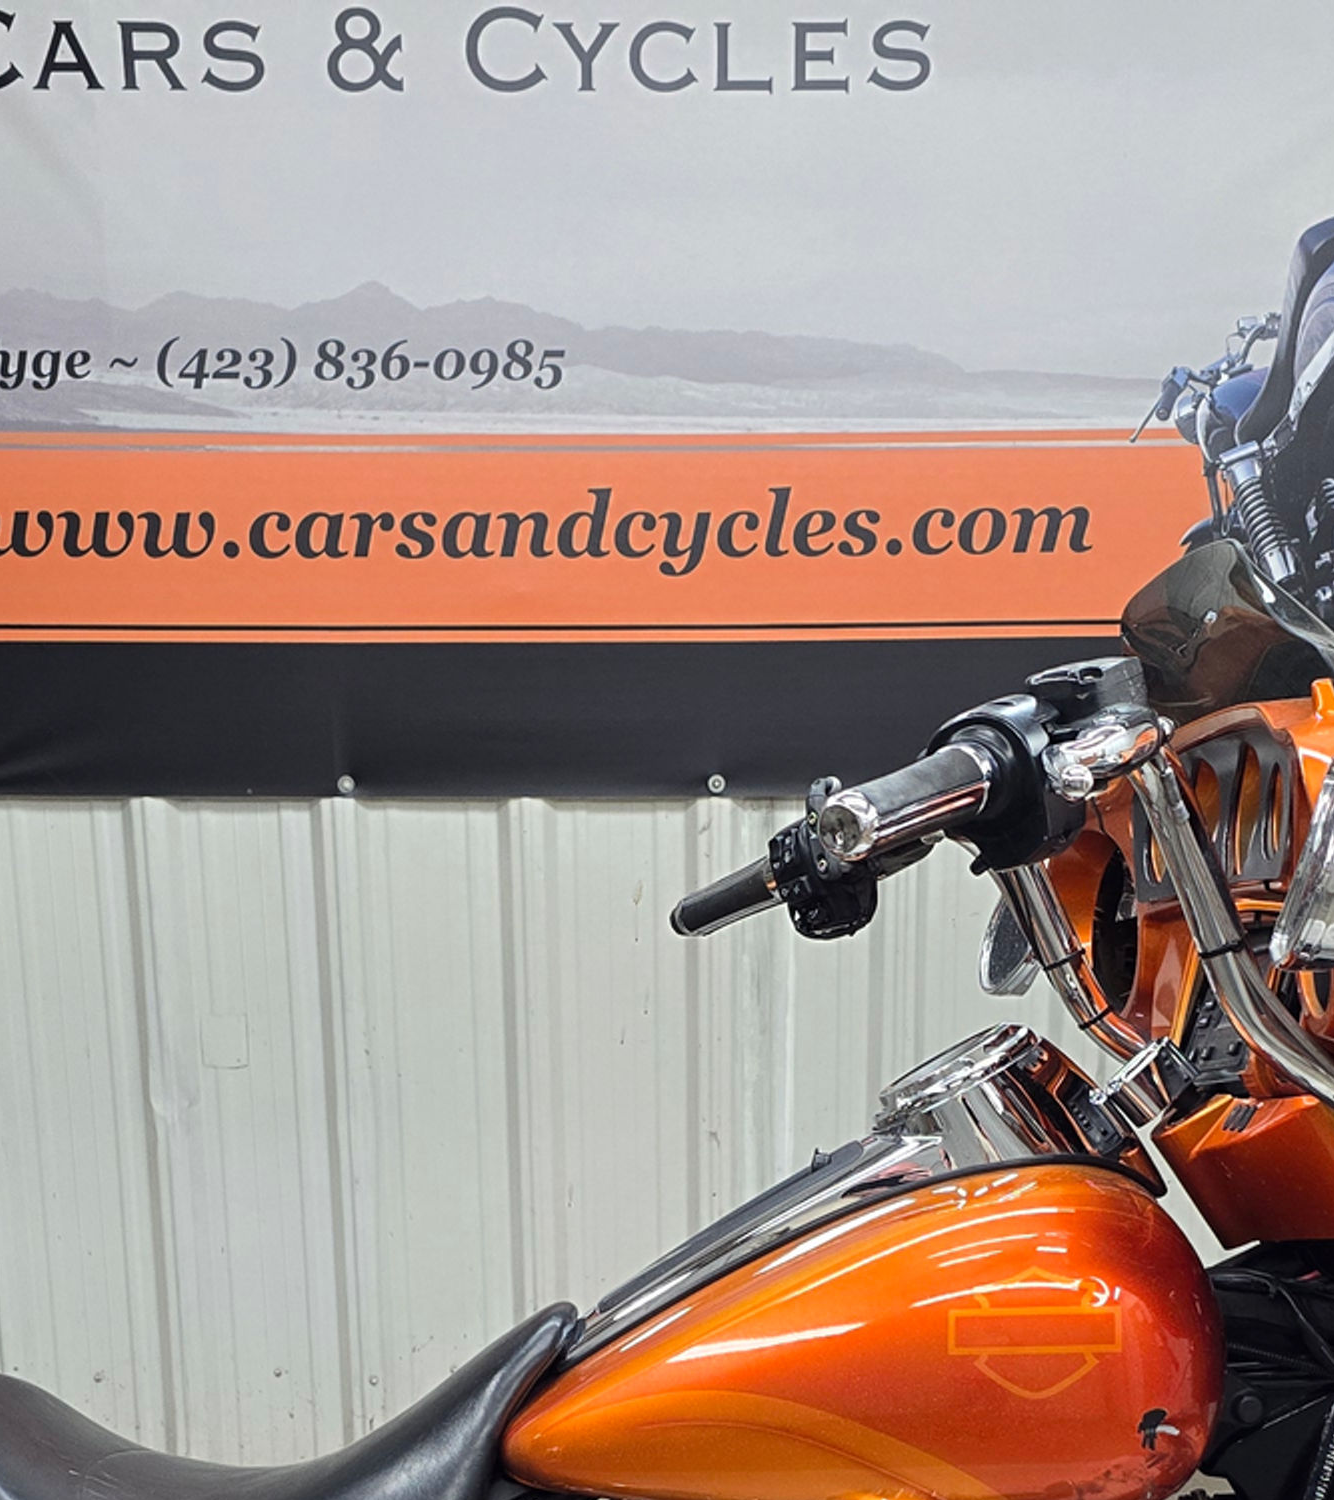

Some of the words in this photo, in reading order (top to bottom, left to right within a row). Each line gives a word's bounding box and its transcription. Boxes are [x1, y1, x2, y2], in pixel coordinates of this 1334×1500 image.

[327, 7, 404, 93] &
[157, 336, 298, 390] (423)
[314, 338, 566, 390] 836-0985
